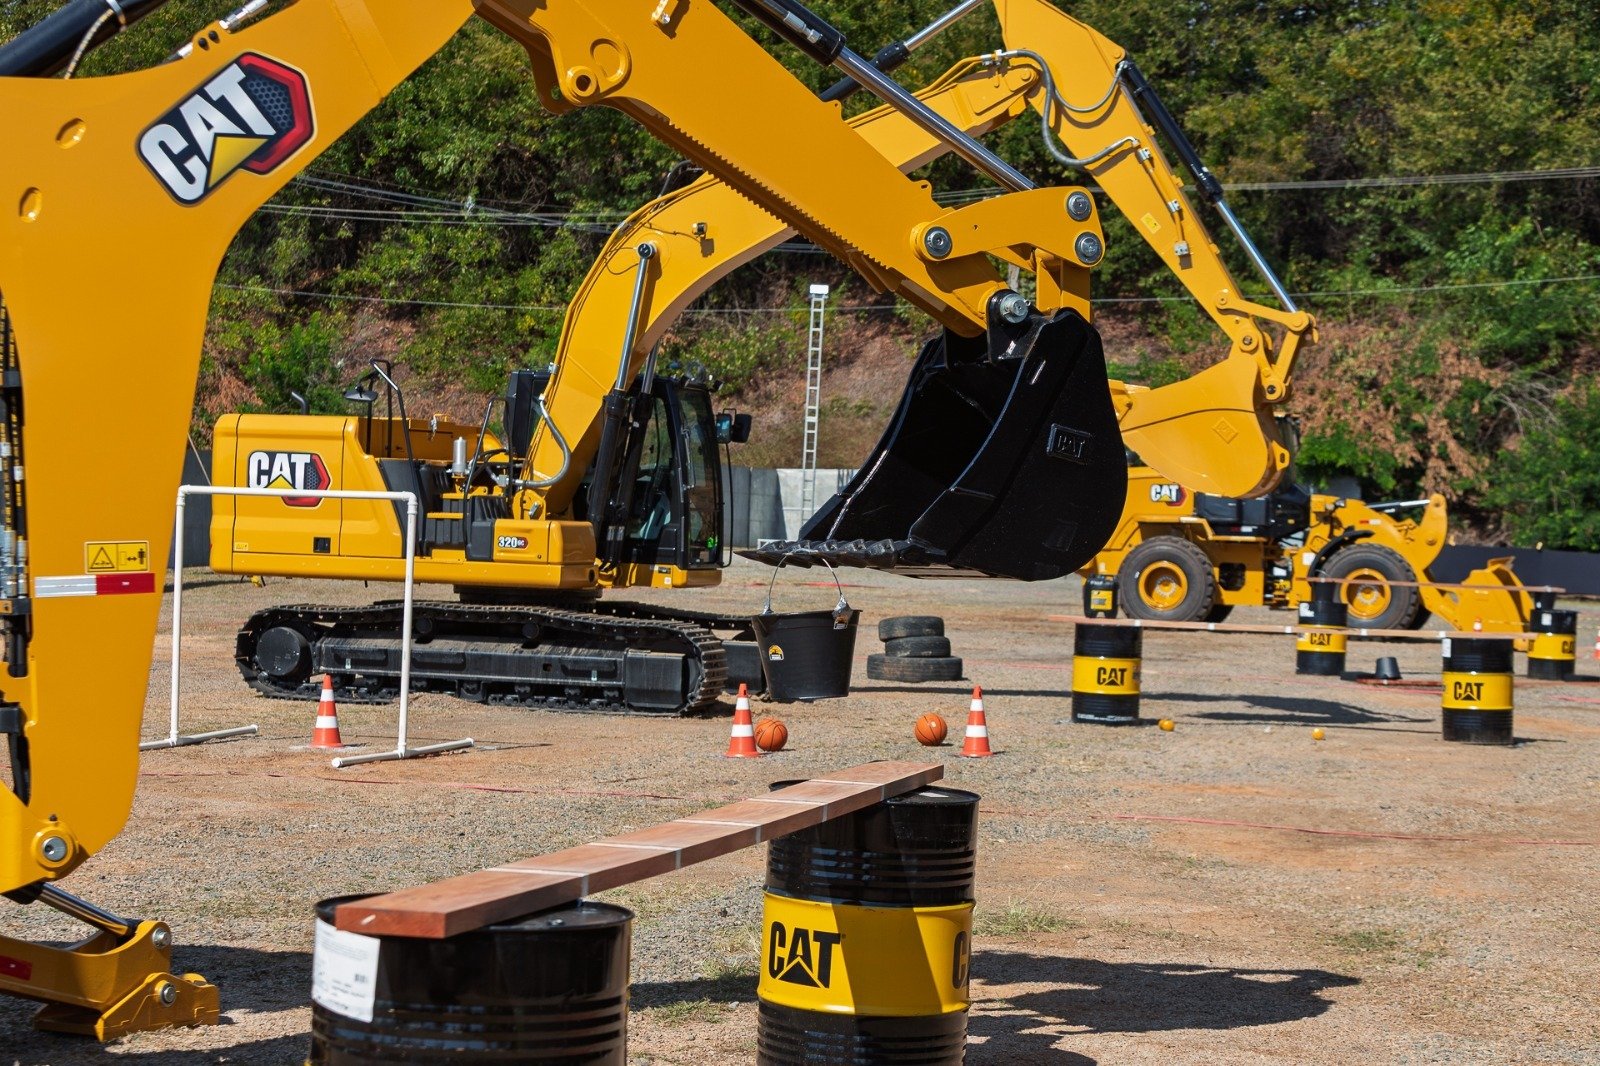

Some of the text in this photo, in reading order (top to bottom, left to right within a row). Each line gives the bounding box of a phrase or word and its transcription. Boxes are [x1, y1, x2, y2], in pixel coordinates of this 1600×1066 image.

[139, 63, 277, 200] CAT
[249, 451, 311, 489] CAT
[1151, 484, 1179, 502] CAT
[498, 536, 517, 548] 320
[1310, 633, 1332, 646] CAT
[1097, 666, 1127, 686] CAT
[1454, 681, 1484, 701] CAT
[769, 920, 841, 989] CAT
